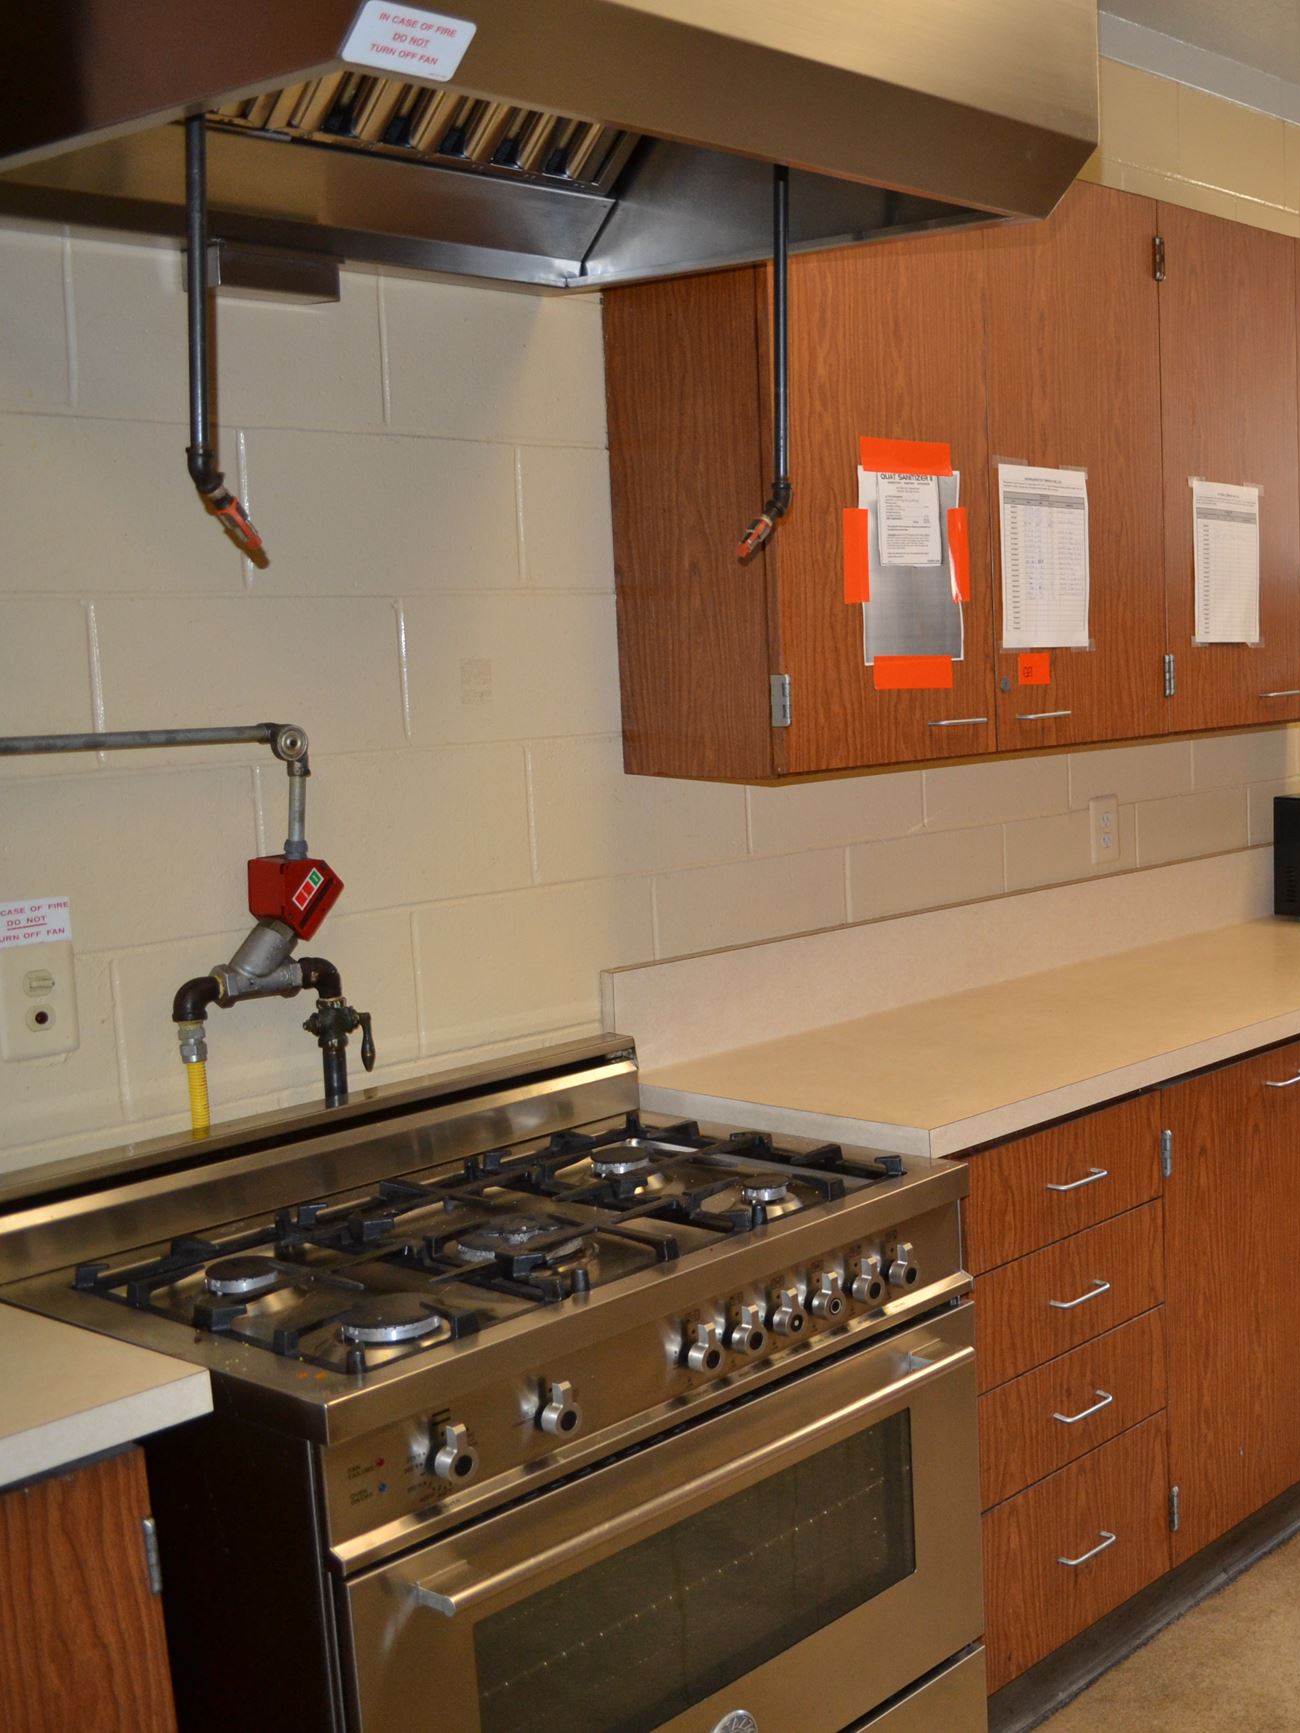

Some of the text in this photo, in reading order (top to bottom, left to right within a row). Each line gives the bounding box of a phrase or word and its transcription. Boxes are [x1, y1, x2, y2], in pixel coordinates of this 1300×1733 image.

[378, 12, 457, 38] IN CASE OF FIRE
[392, 32, 430, 49] DO NOT
[370, 43, 438, 66] TURN OFF FAN
[0, 907, 25, 917] CASE
[48, 901, 70, 910] FIRE
[6, 915, 46, 927] DO NOT
[0, 928, 65, 943] URN OFF FAN
